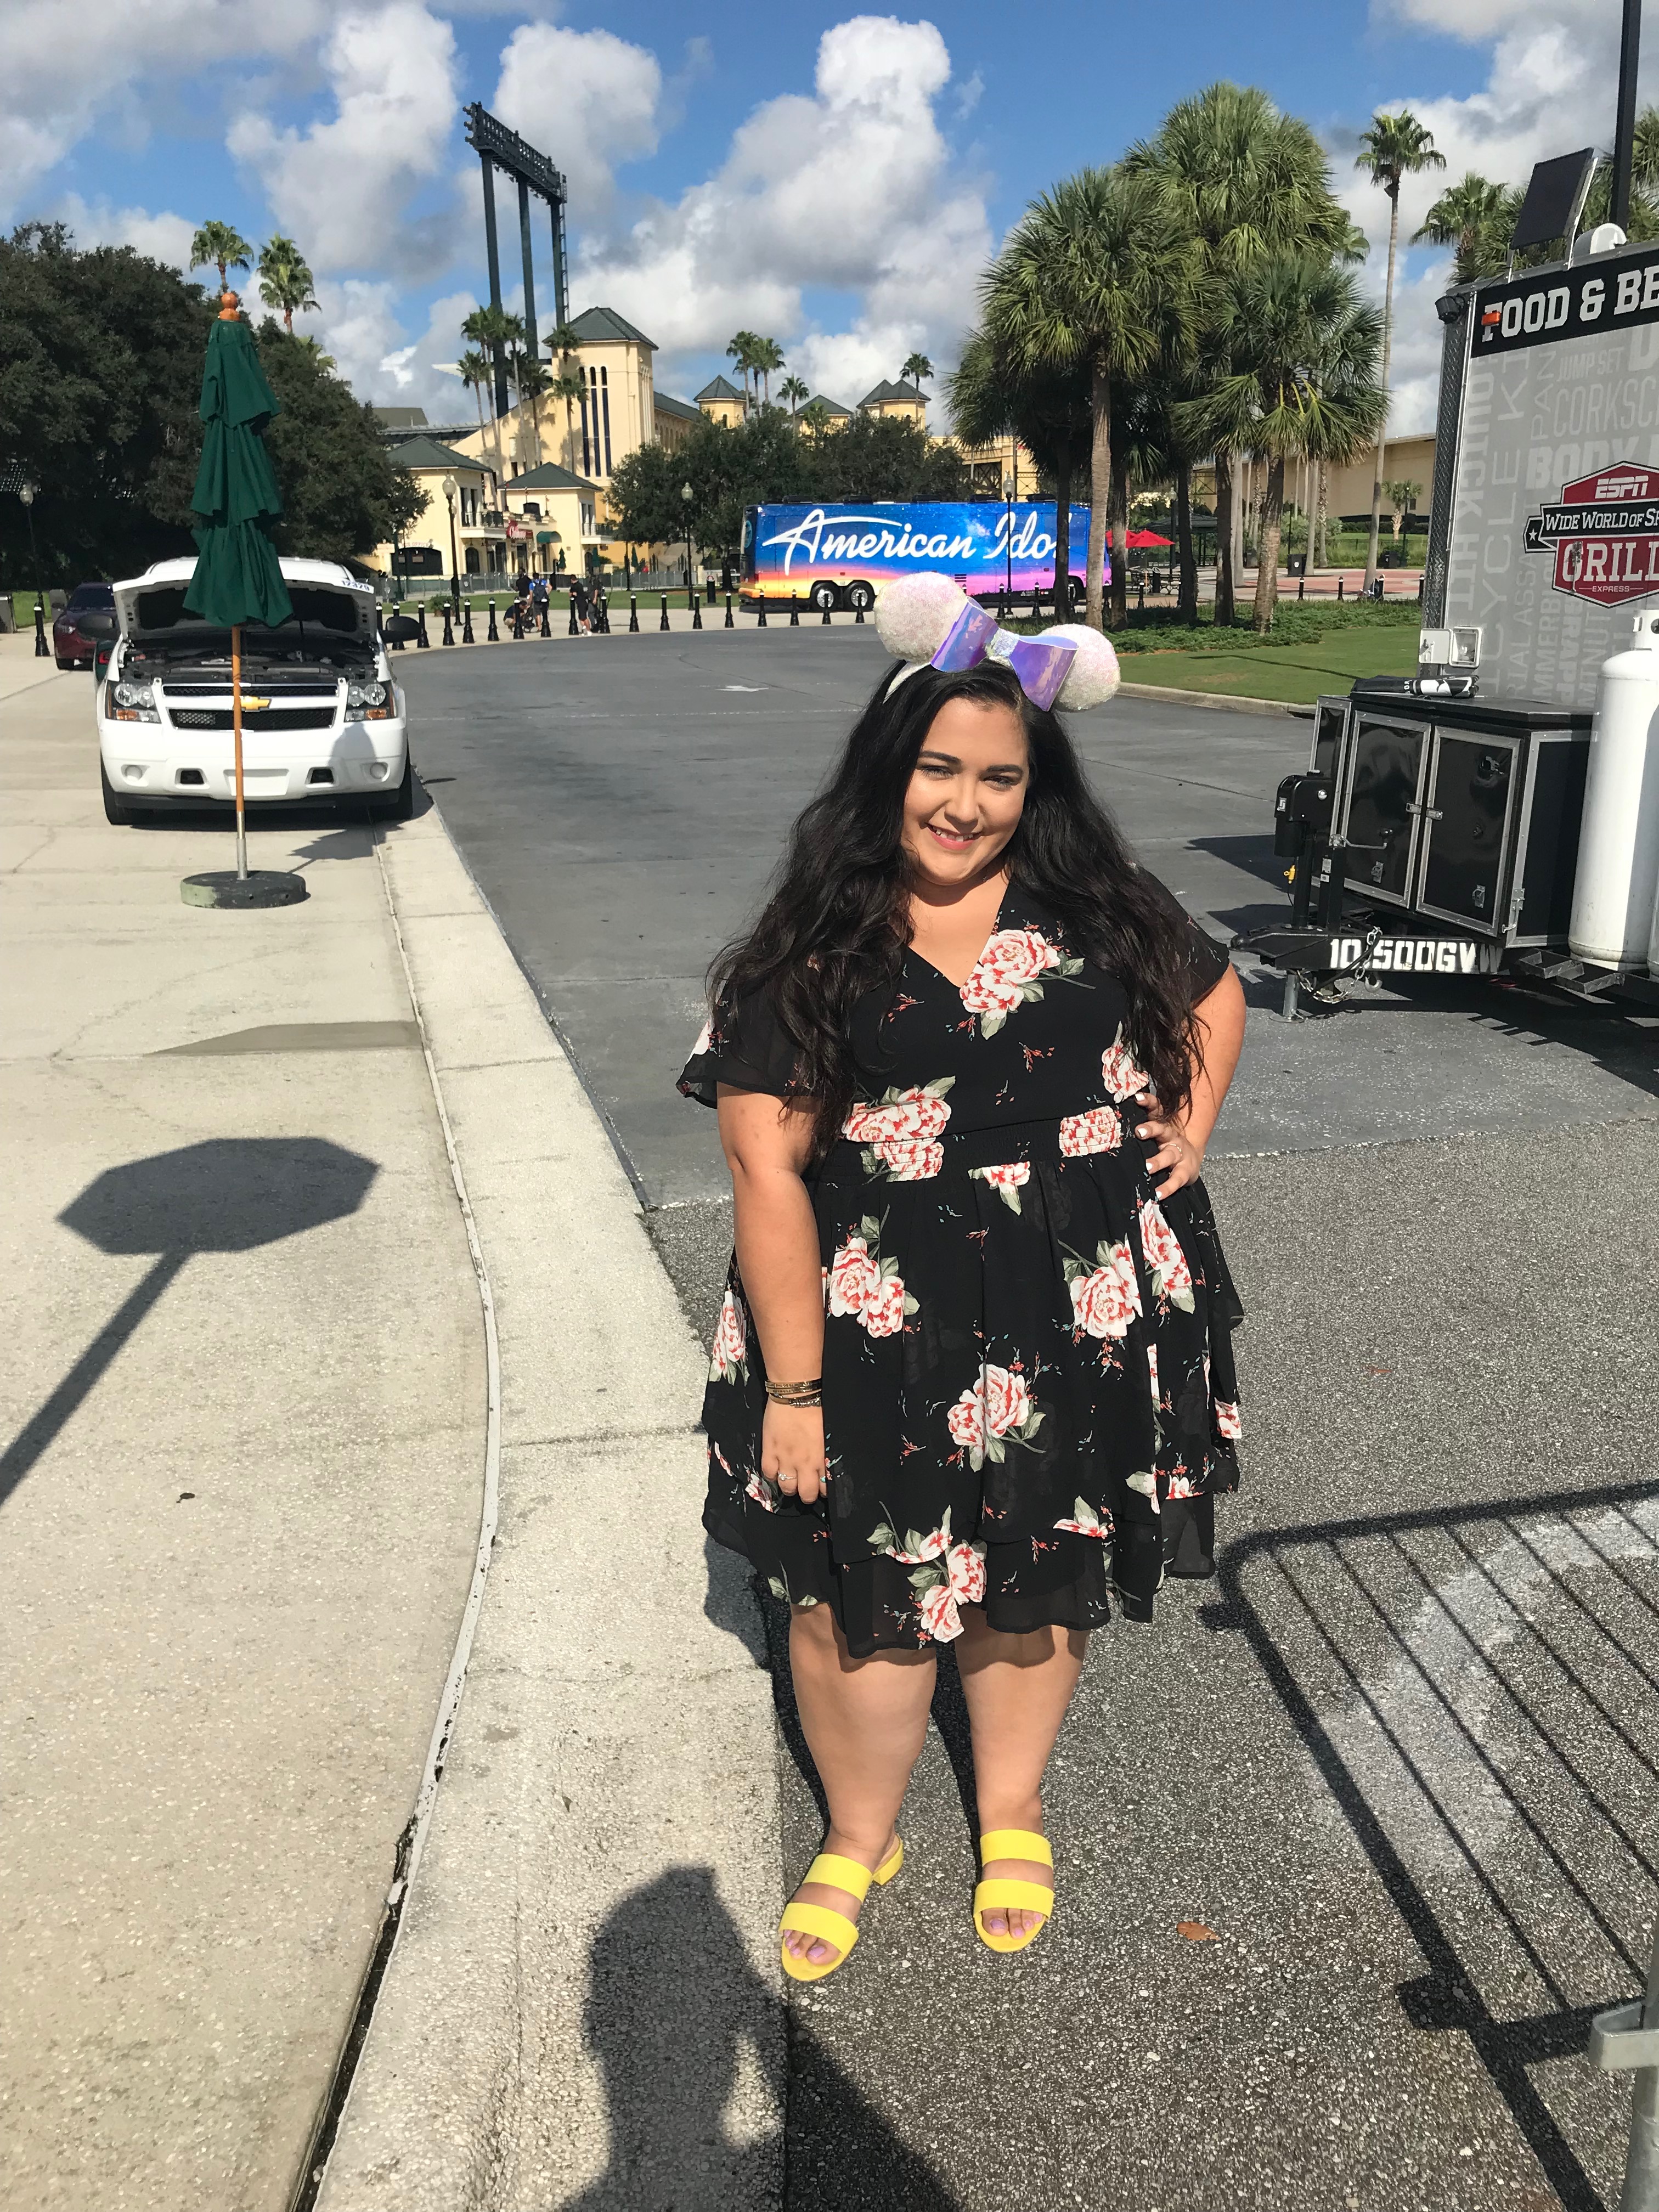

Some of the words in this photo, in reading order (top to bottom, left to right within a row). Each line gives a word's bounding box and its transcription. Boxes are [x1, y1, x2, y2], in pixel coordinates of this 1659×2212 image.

[1482, 286, 1570, 342] FOOD
[1579, 279, 1606, 321] &
[1614, 266, 1659, 315] BE
[1553, 375, 1659, 438] CORKSC
[1595, 475, 1649, 499] ESPN
[762, 509, 977, 576] American
[983, 511, 1073, 559] Ido
[1545, 514, 1580, 531] WIDE
[1582, 511, 1628, 529] WORLD
[1629, 513, 1645, 528] OF
[1562, 541, 1659, 582] GRILL
